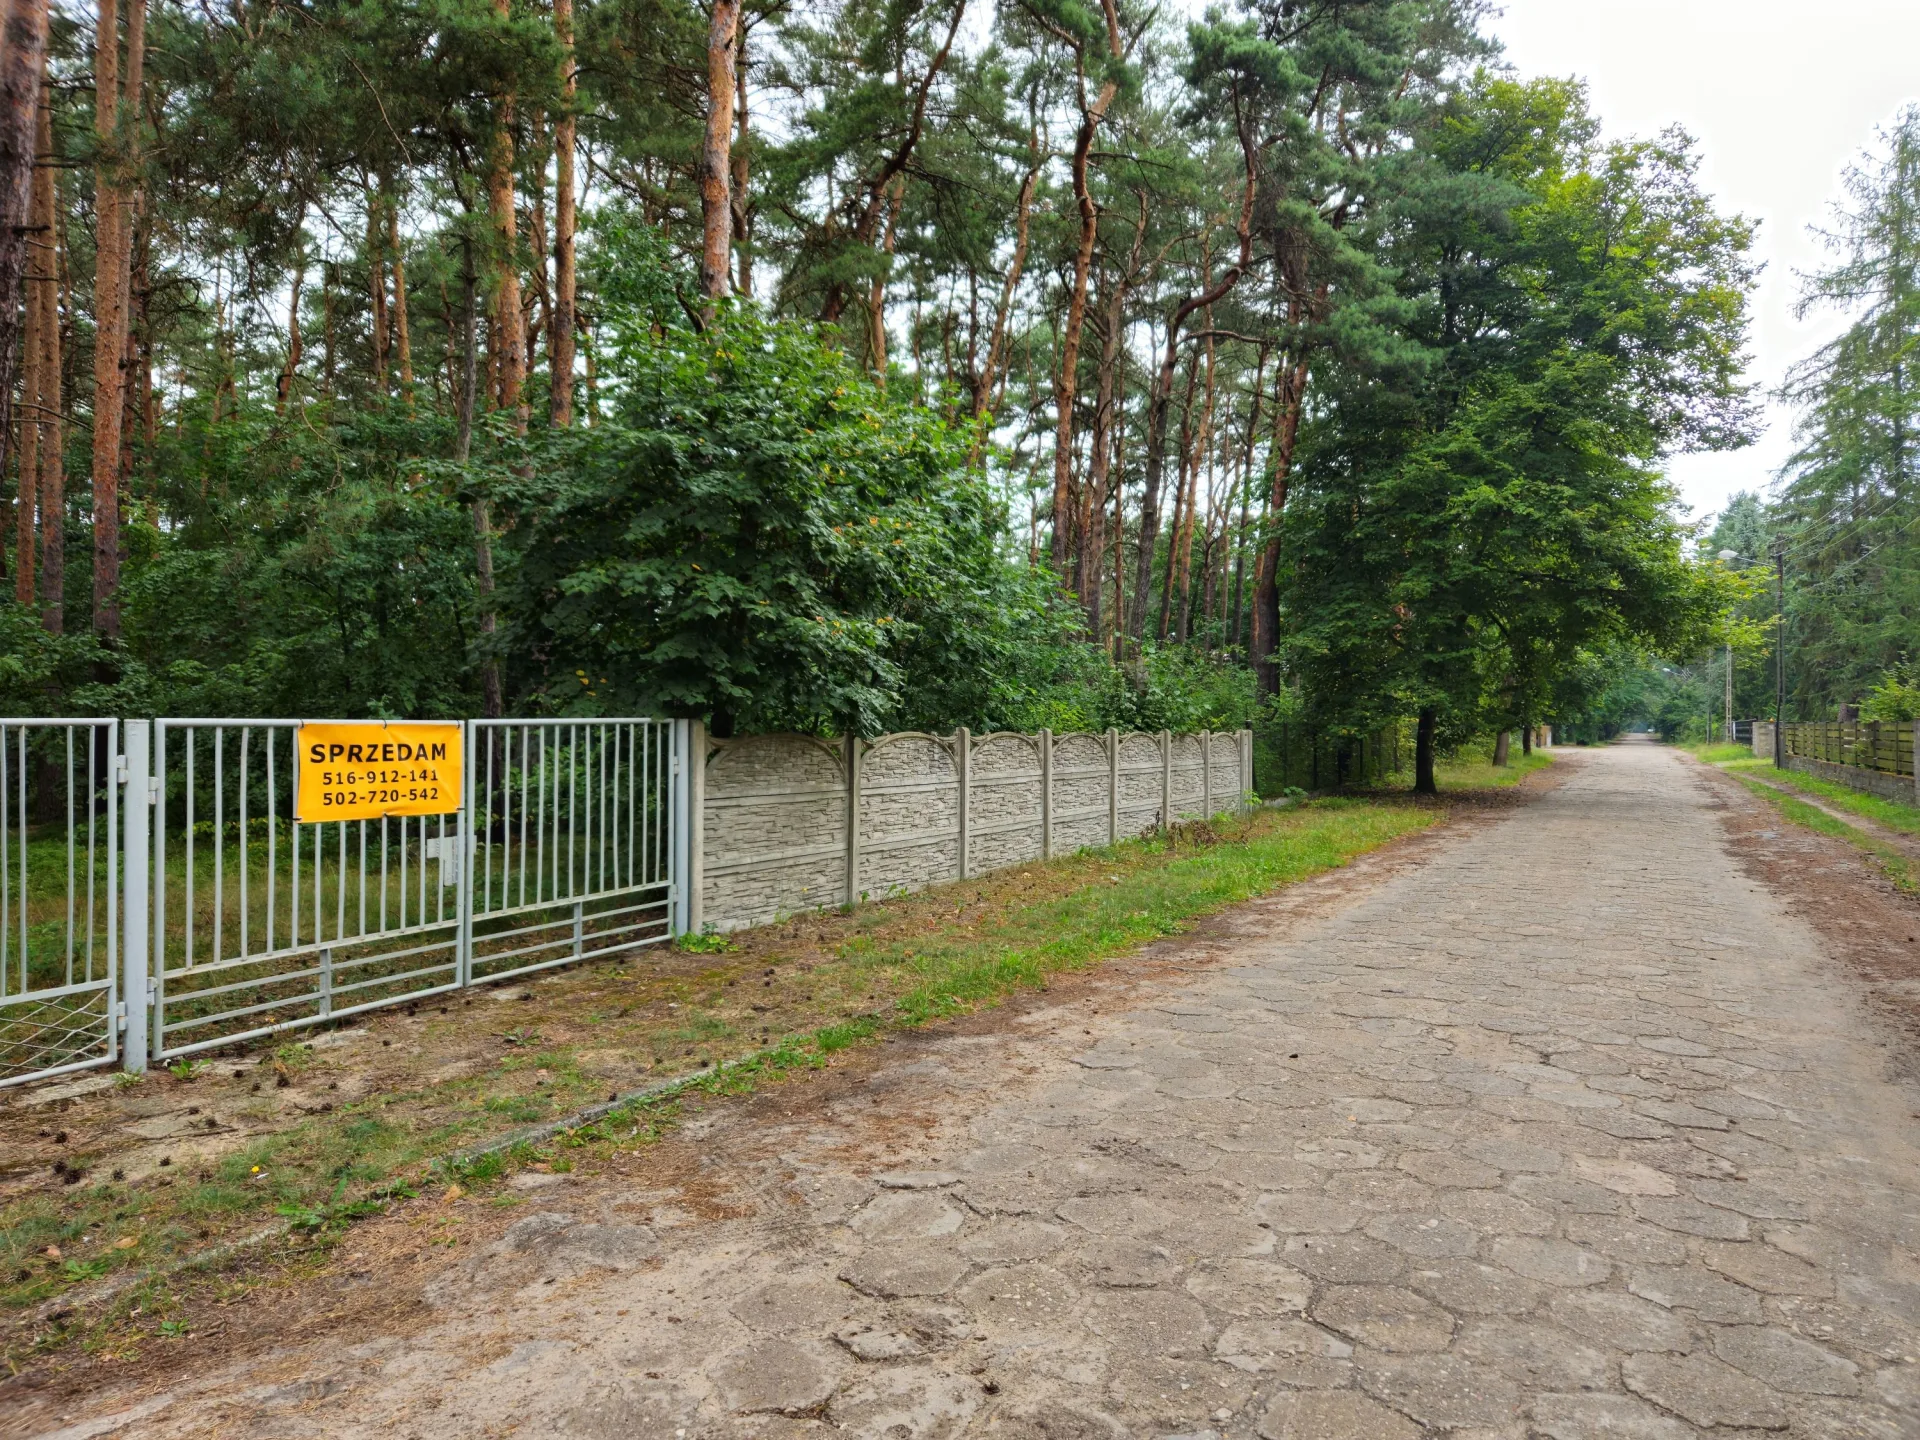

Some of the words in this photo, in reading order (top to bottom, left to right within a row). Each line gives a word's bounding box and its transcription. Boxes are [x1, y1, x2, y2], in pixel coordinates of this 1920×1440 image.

[310, 743, 446, 763] SPRZEDAM
[323, 769, 438, 785] 516-912-141
[323, 787, 438, 806] 502-720-542
